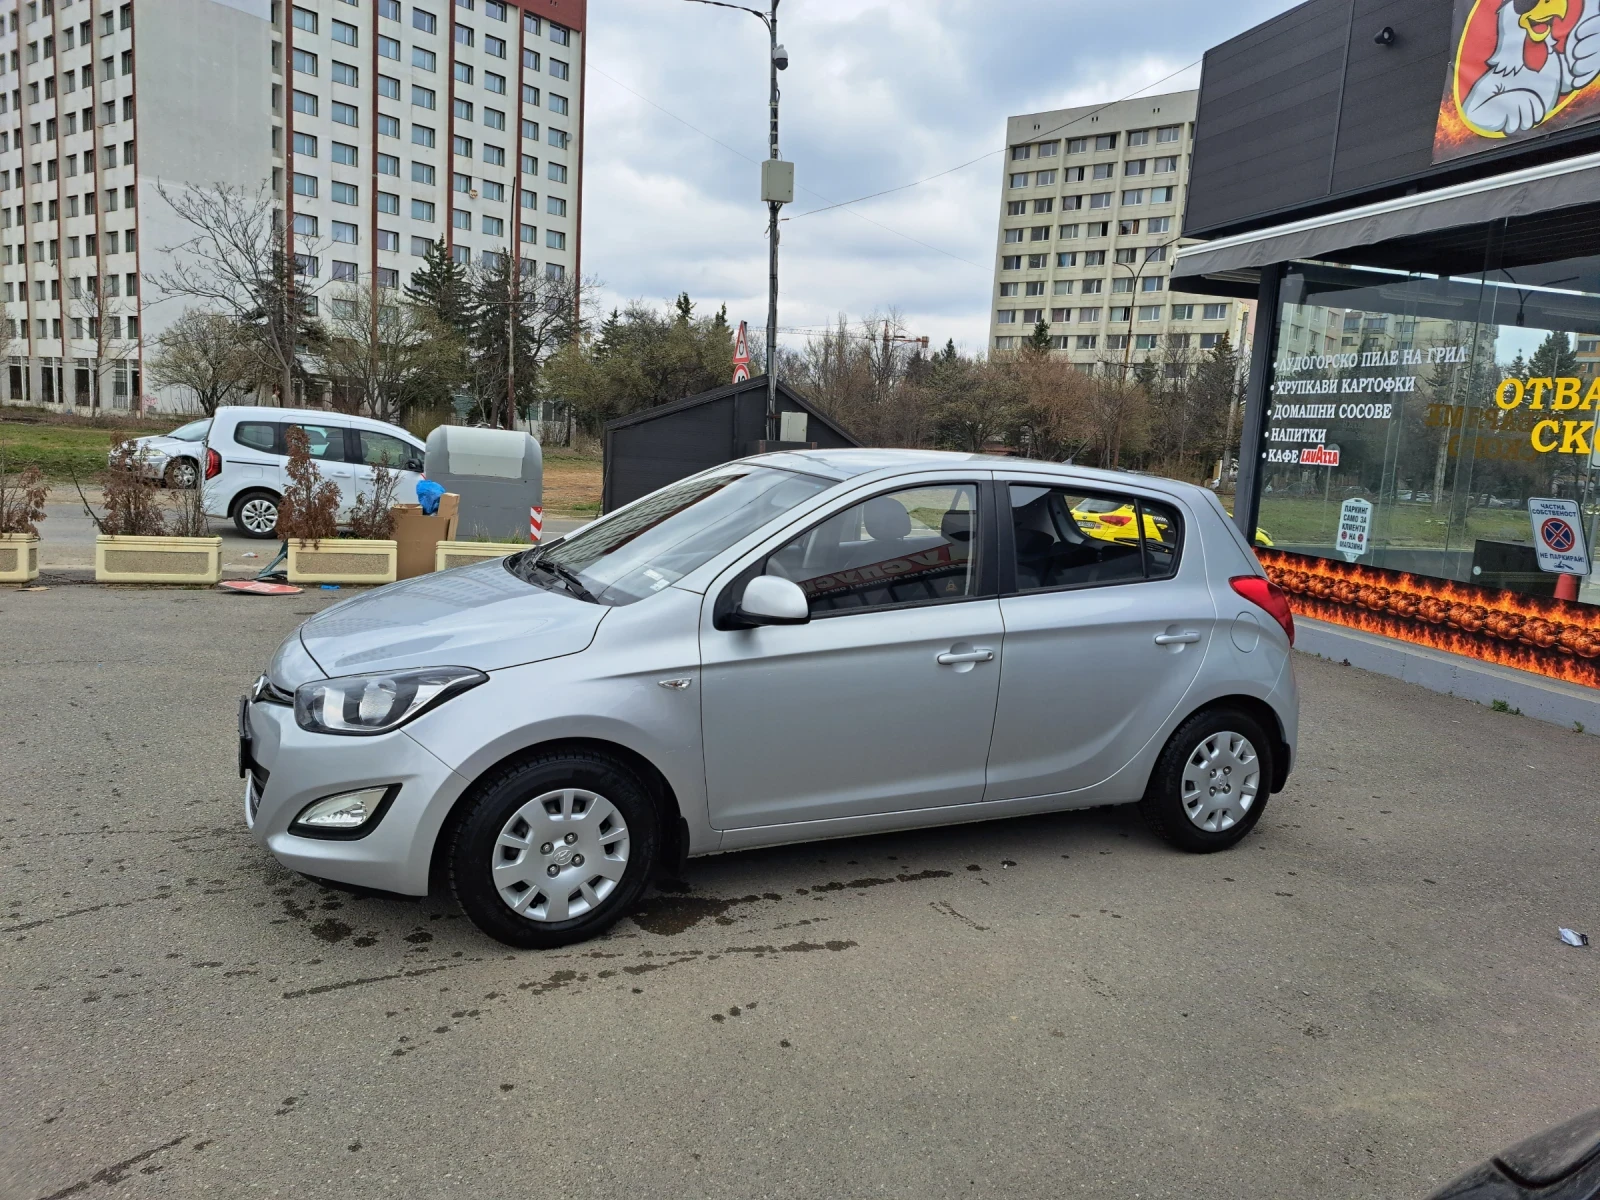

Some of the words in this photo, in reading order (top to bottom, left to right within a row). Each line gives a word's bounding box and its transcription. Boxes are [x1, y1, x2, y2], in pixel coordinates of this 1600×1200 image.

[1279, 353, 1358, 372] ЛУДОГОРСКО
[1361, 350, 1399, 367] ПИЛЕ
[1402, 349, 1422, 365] НА
[1426, 347, 1466, 363] ГРИЛ
[1276, 379, 1338, 394] ХРУПКАВИ
[1341, 376, 1416, 393] КАРТОФКИ
[1273, 404, 1336, 420] ДОМАШНИ
[1338, 403, 1392, 419] СОСОВЕ
[1270, 428, 1327, 443] НАПИТКИ
[1531, 419, 1600, 454] СК
[1267, 449, 1299, 464] КАФЕ
[1301, 445, 1338, 464] LAVAZZA
[1344, 505, 1368, 514] ПАРКИНГ
[1532, 509, 1576, 517] СОБСТВЕНОСТ
[1343, 514, 1359, 523] САМО
[1360, 516, 1367, 524] ЗА
[1342, 523, 1366, 533] КЛИЕНТИ
[1339, 541, 1363, 551] МАГАЗИНА
[1549, 553, 1585, 563] ПАРКИРАЙ!
